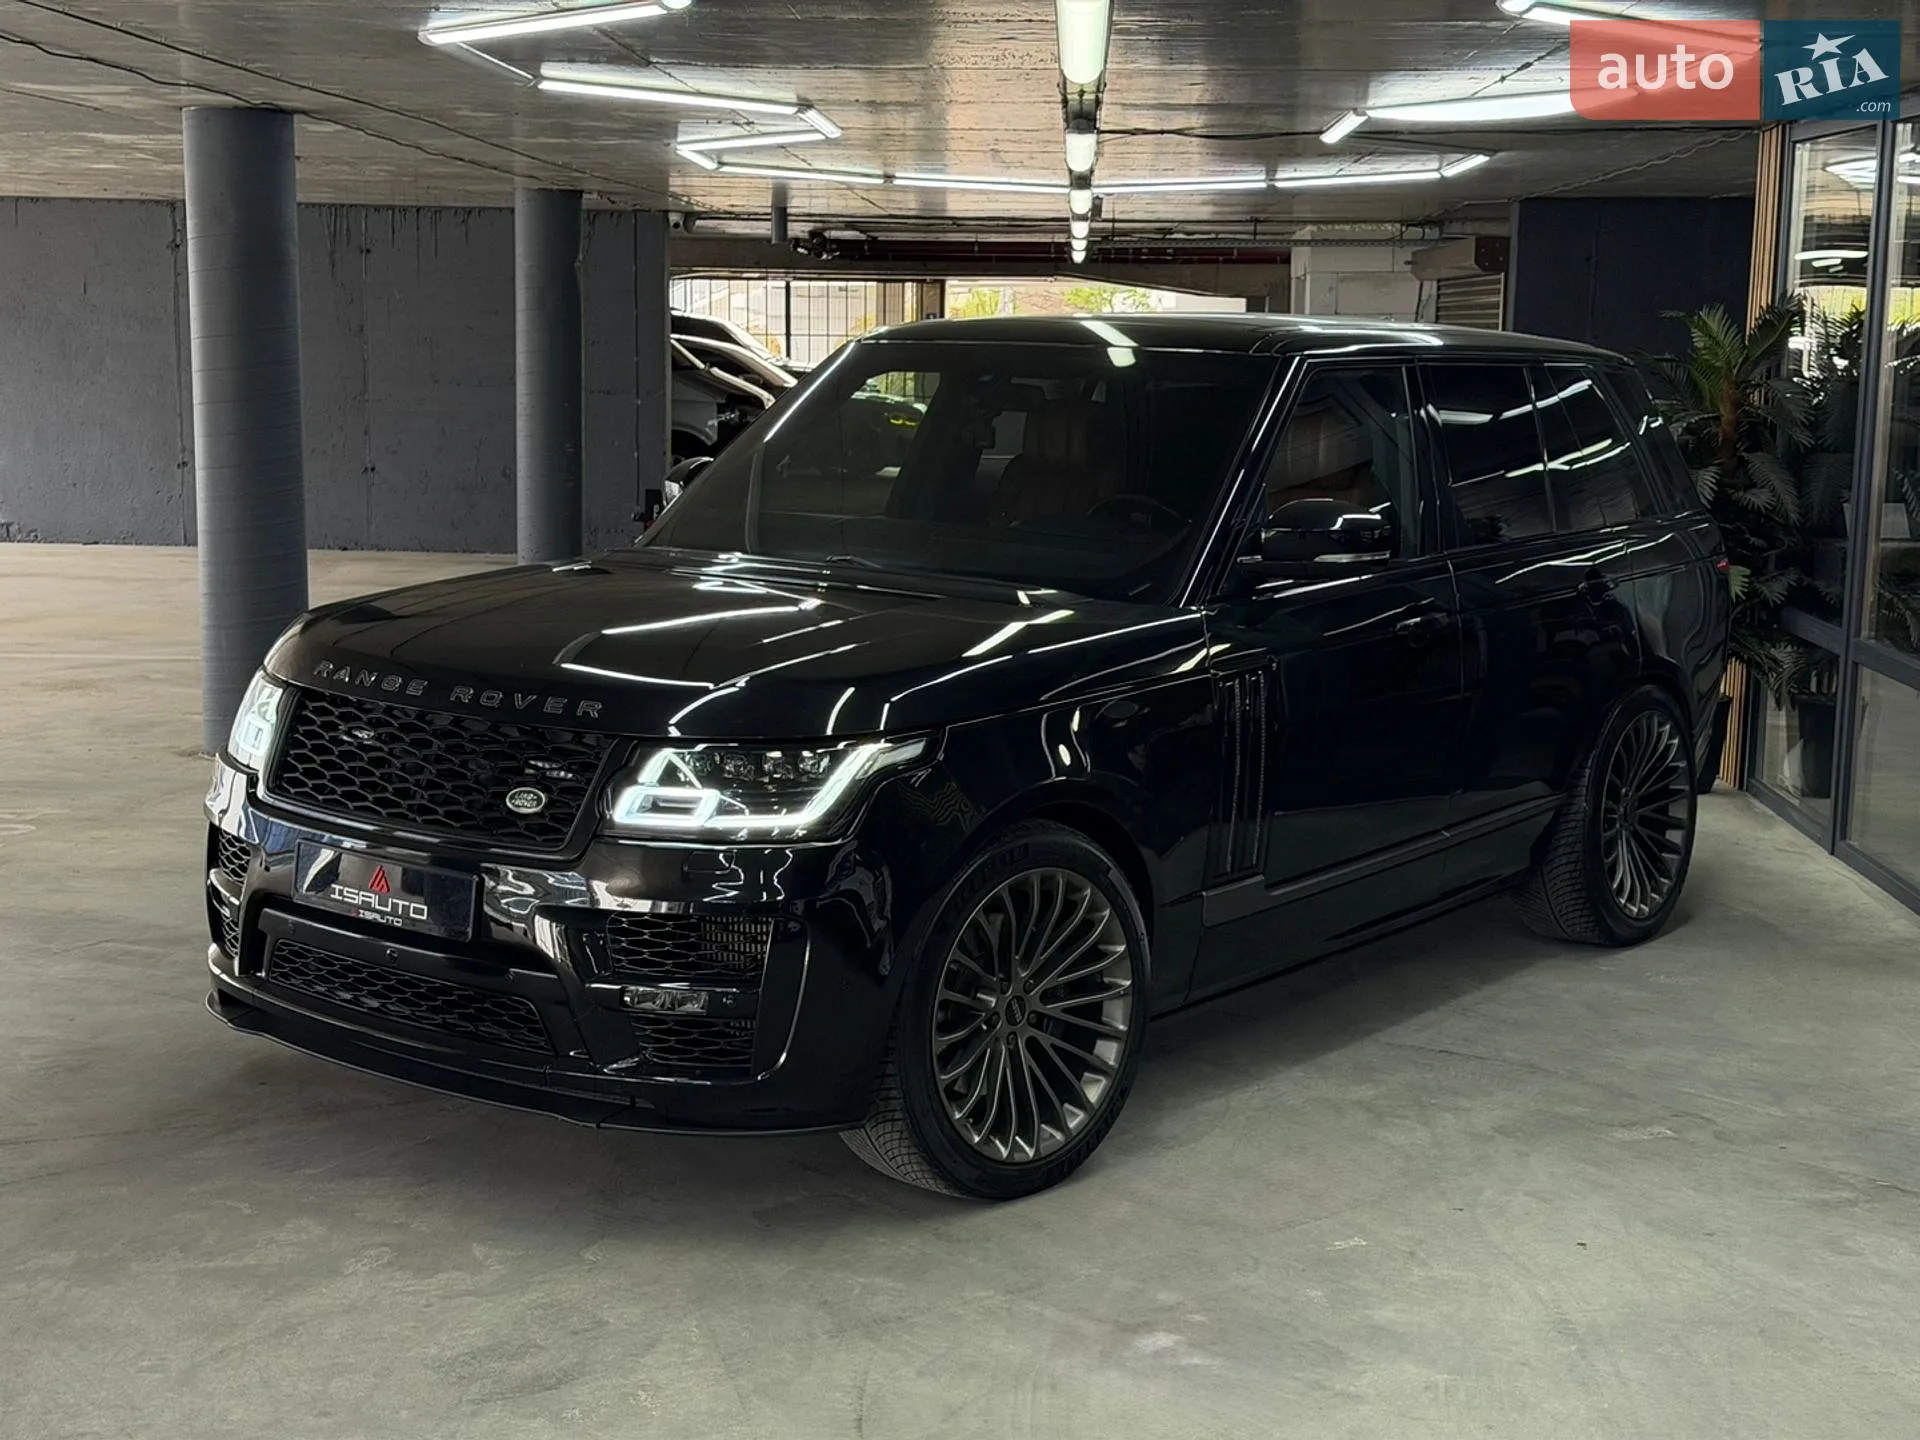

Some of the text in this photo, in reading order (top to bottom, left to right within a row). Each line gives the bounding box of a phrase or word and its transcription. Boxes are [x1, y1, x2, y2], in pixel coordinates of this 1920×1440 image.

[313, 660, 603, 718] RANGE ROVER
[330, 884, 428, 920] ISAUTO
